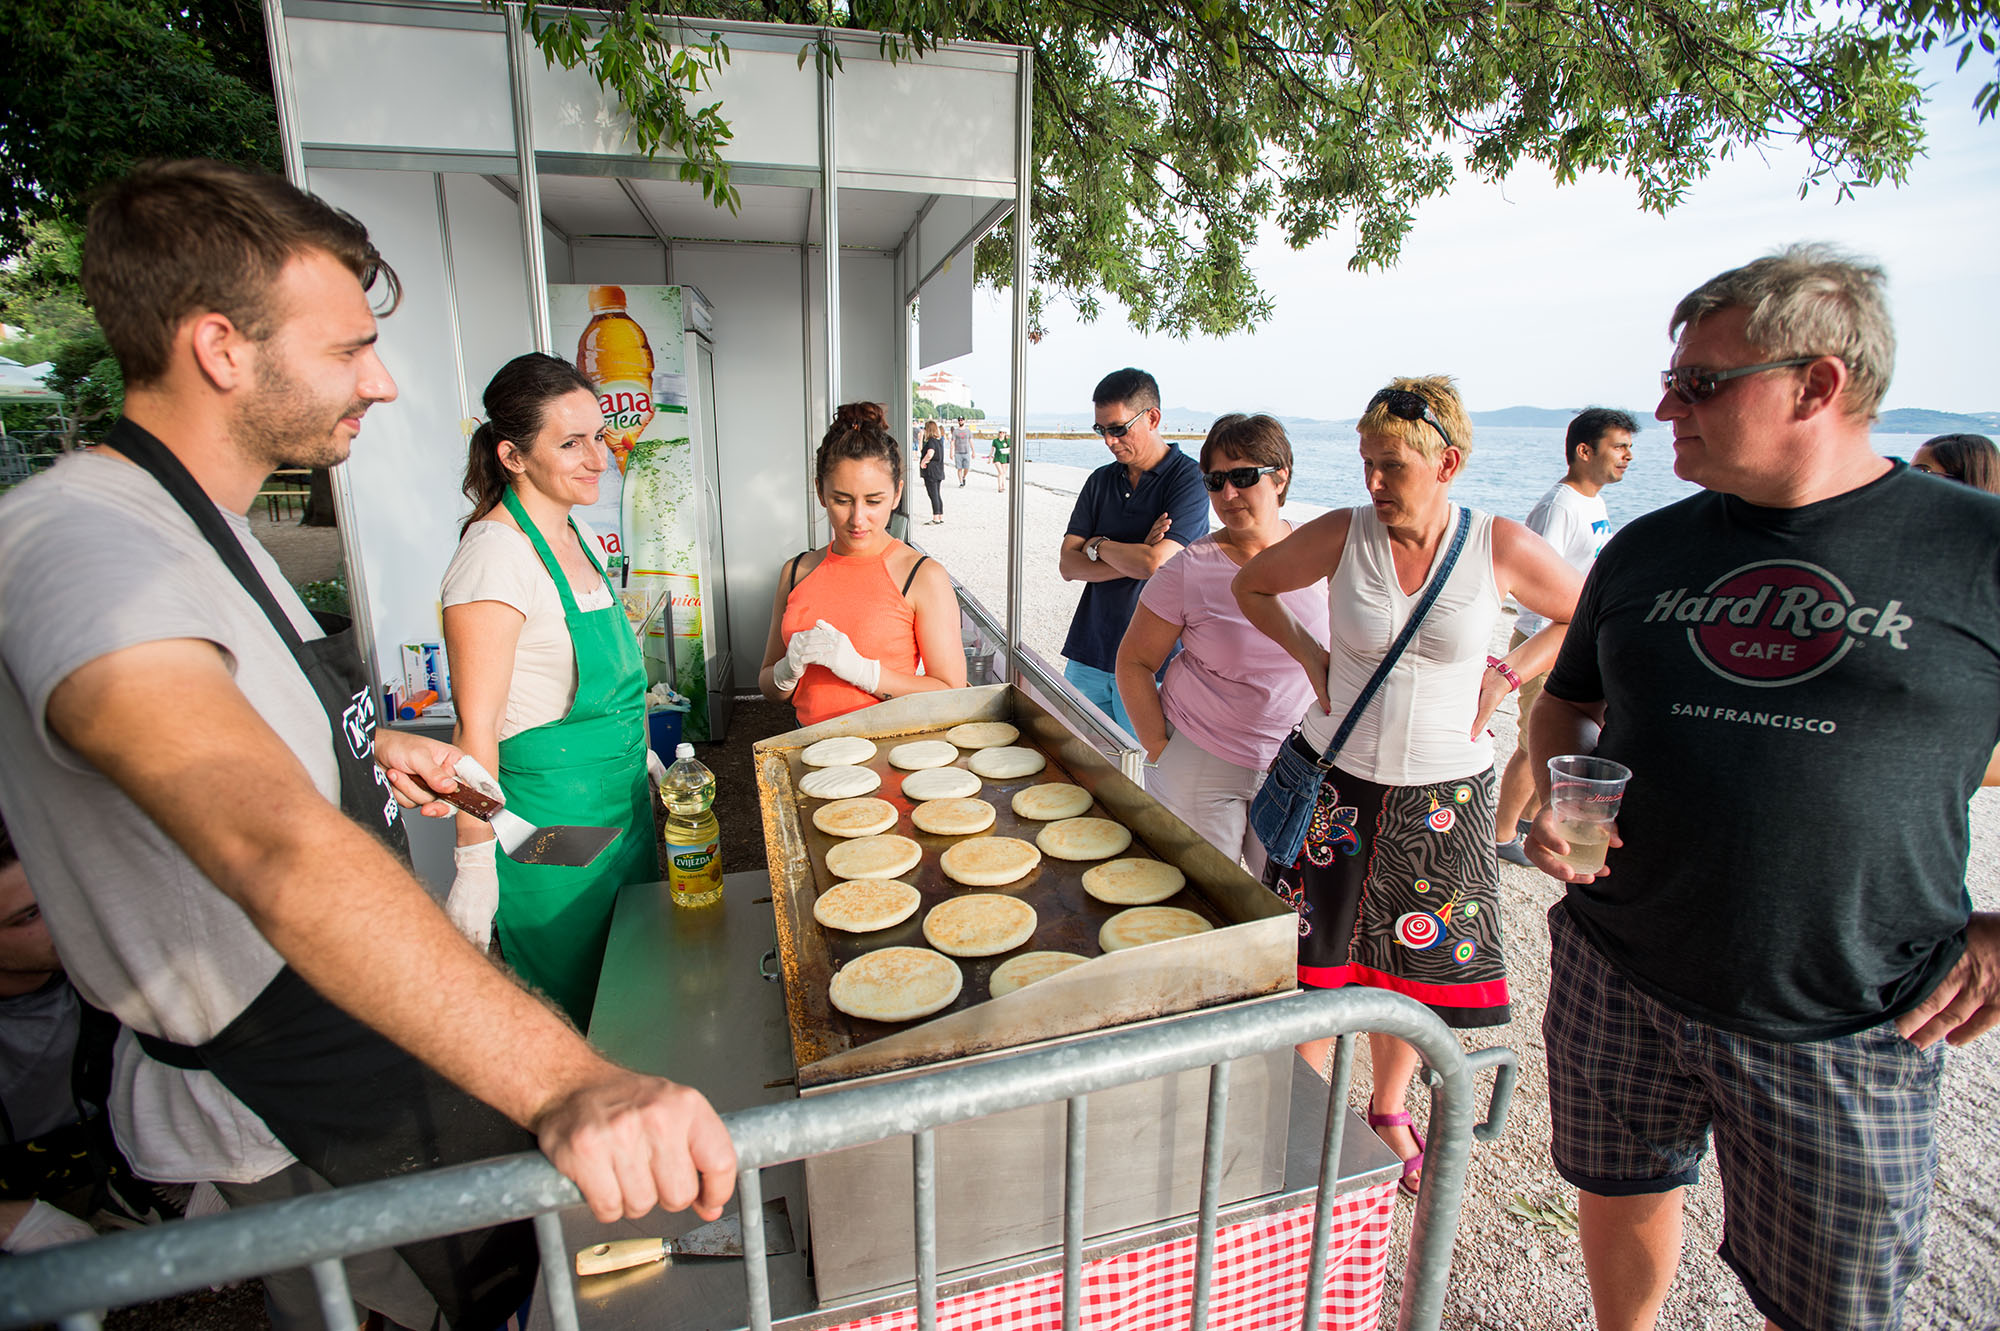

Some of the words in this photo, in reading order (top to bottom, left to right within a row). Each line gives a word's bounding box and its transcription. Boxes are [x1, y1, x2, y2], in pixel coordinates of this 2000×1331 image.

[599, 392, 654, 414] ana
[604, 406, 642, 430] Tea
[671, 594, 702, 608] nica
[1643, 585, 1774, 625] Hard
[1771, 586, 1913, 650] Rock
[1729, 640, 1797, 662] CAFE
[1671, 702, 1710, 718] SAN
[1713, 707, 1837, 734] FRANCISCO
[676, 856, 710, 868] ZVIJEZDA
